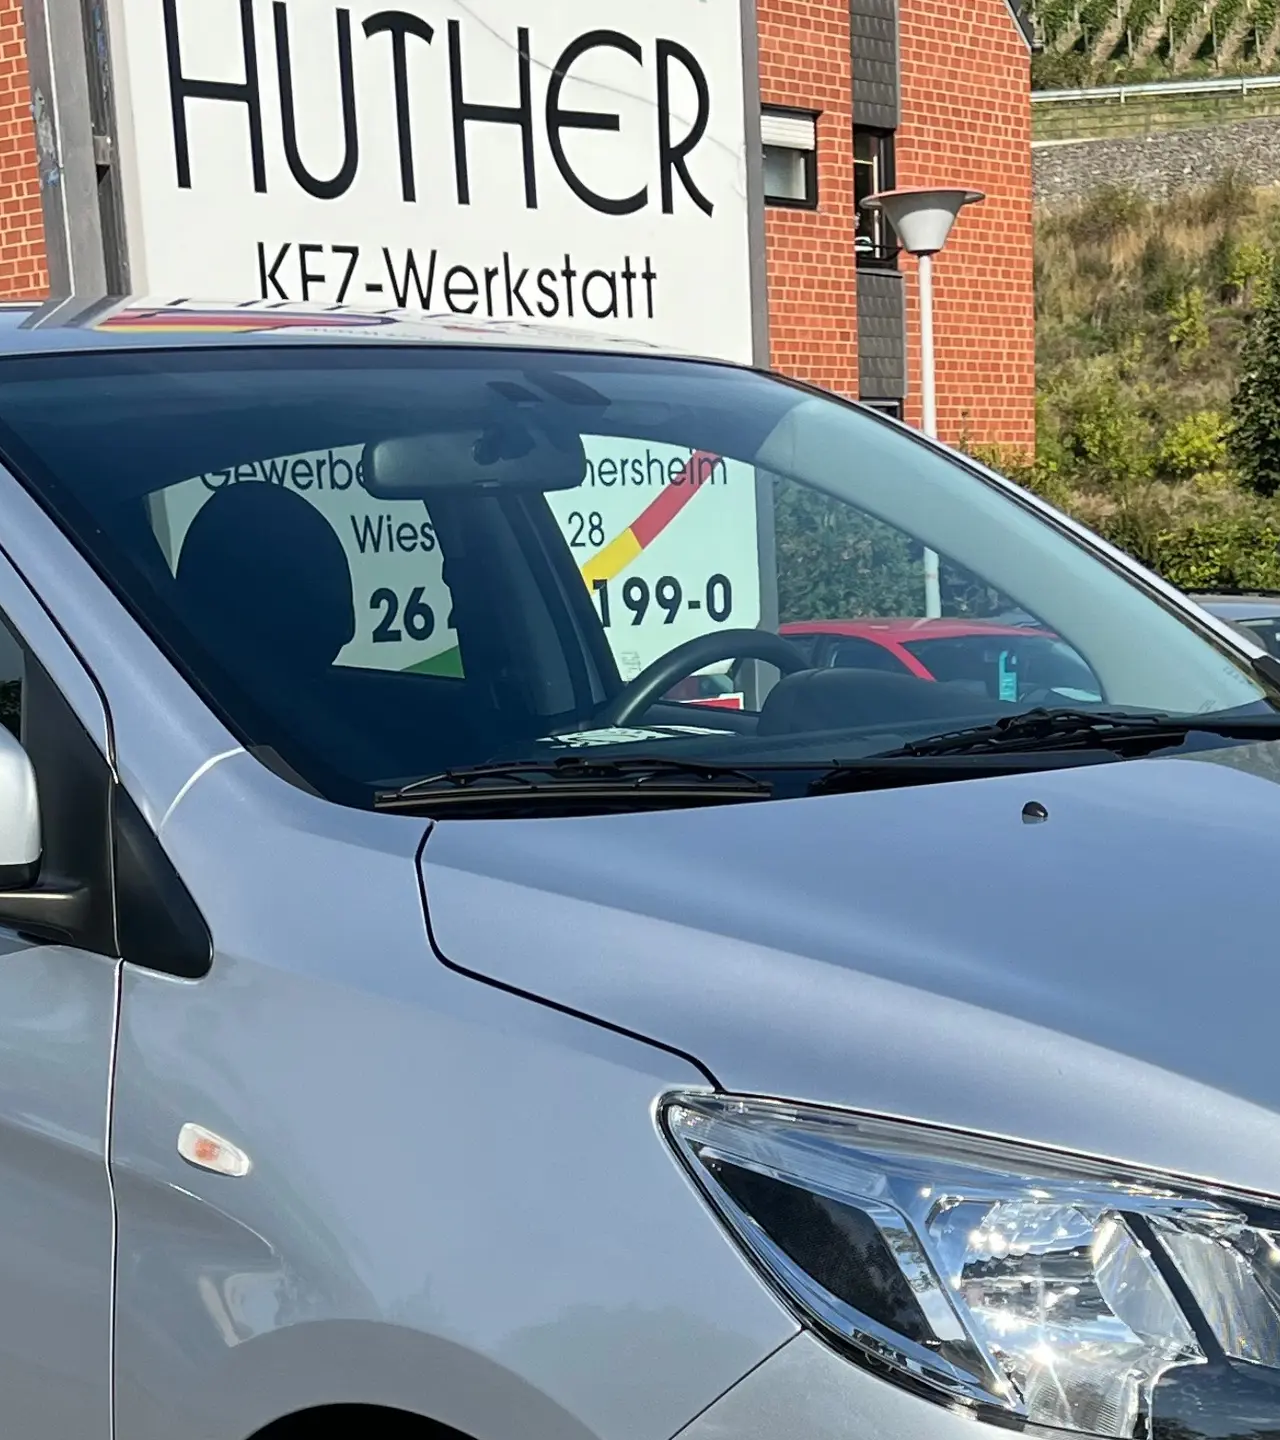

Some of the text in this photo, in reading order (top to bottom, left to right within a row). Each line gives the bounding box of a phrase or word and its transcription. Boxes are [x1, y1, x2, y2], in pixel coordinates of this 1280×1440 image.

[163, 0, 714, 218] HUTHER
[350, 511, 605, 554] Wies 28
